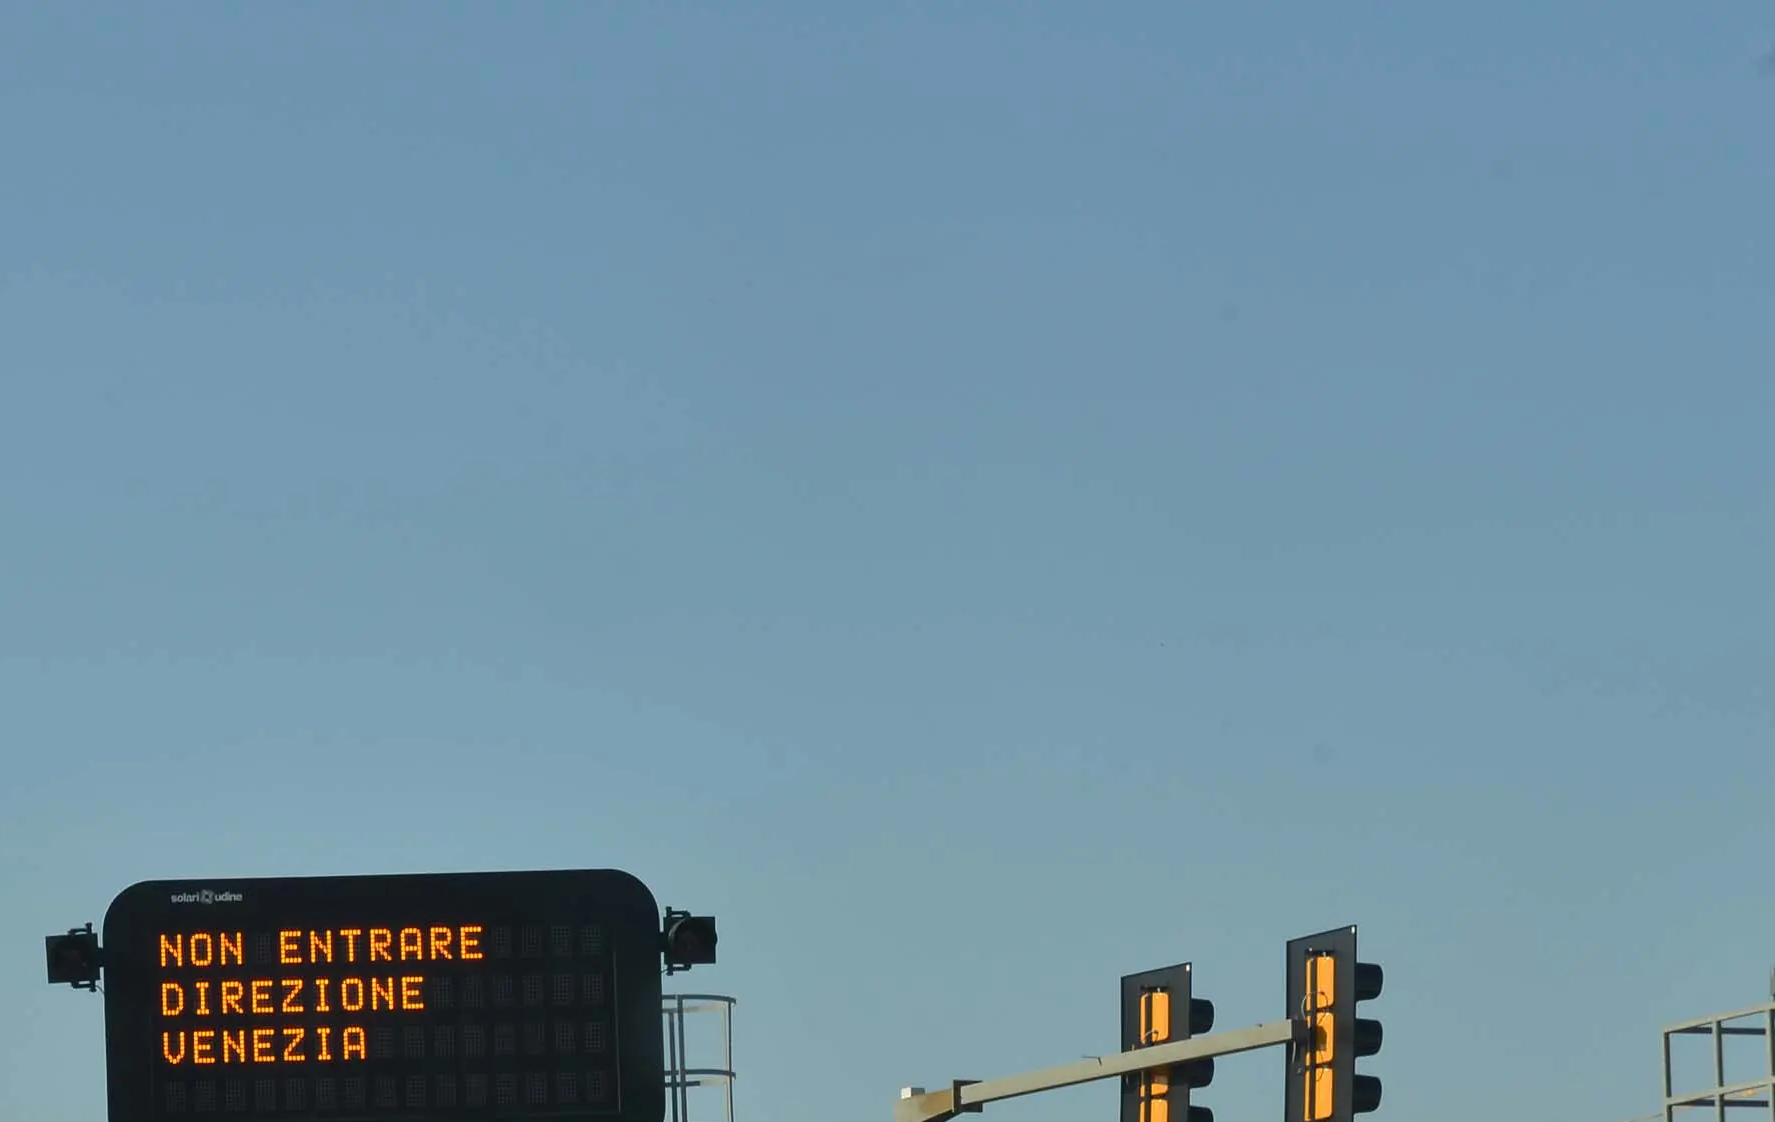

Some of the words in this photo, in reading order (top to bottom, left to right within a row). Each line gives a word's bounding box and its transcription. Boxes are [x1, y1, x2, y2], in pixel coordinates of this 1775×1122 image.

[160, 932, 243, 967] NON
[280, 926, 484, 965] ENTRARE
[161, 976, 424, 1017] DIREZIONE
[162, 1027, 366, 1065] VENEZIA
